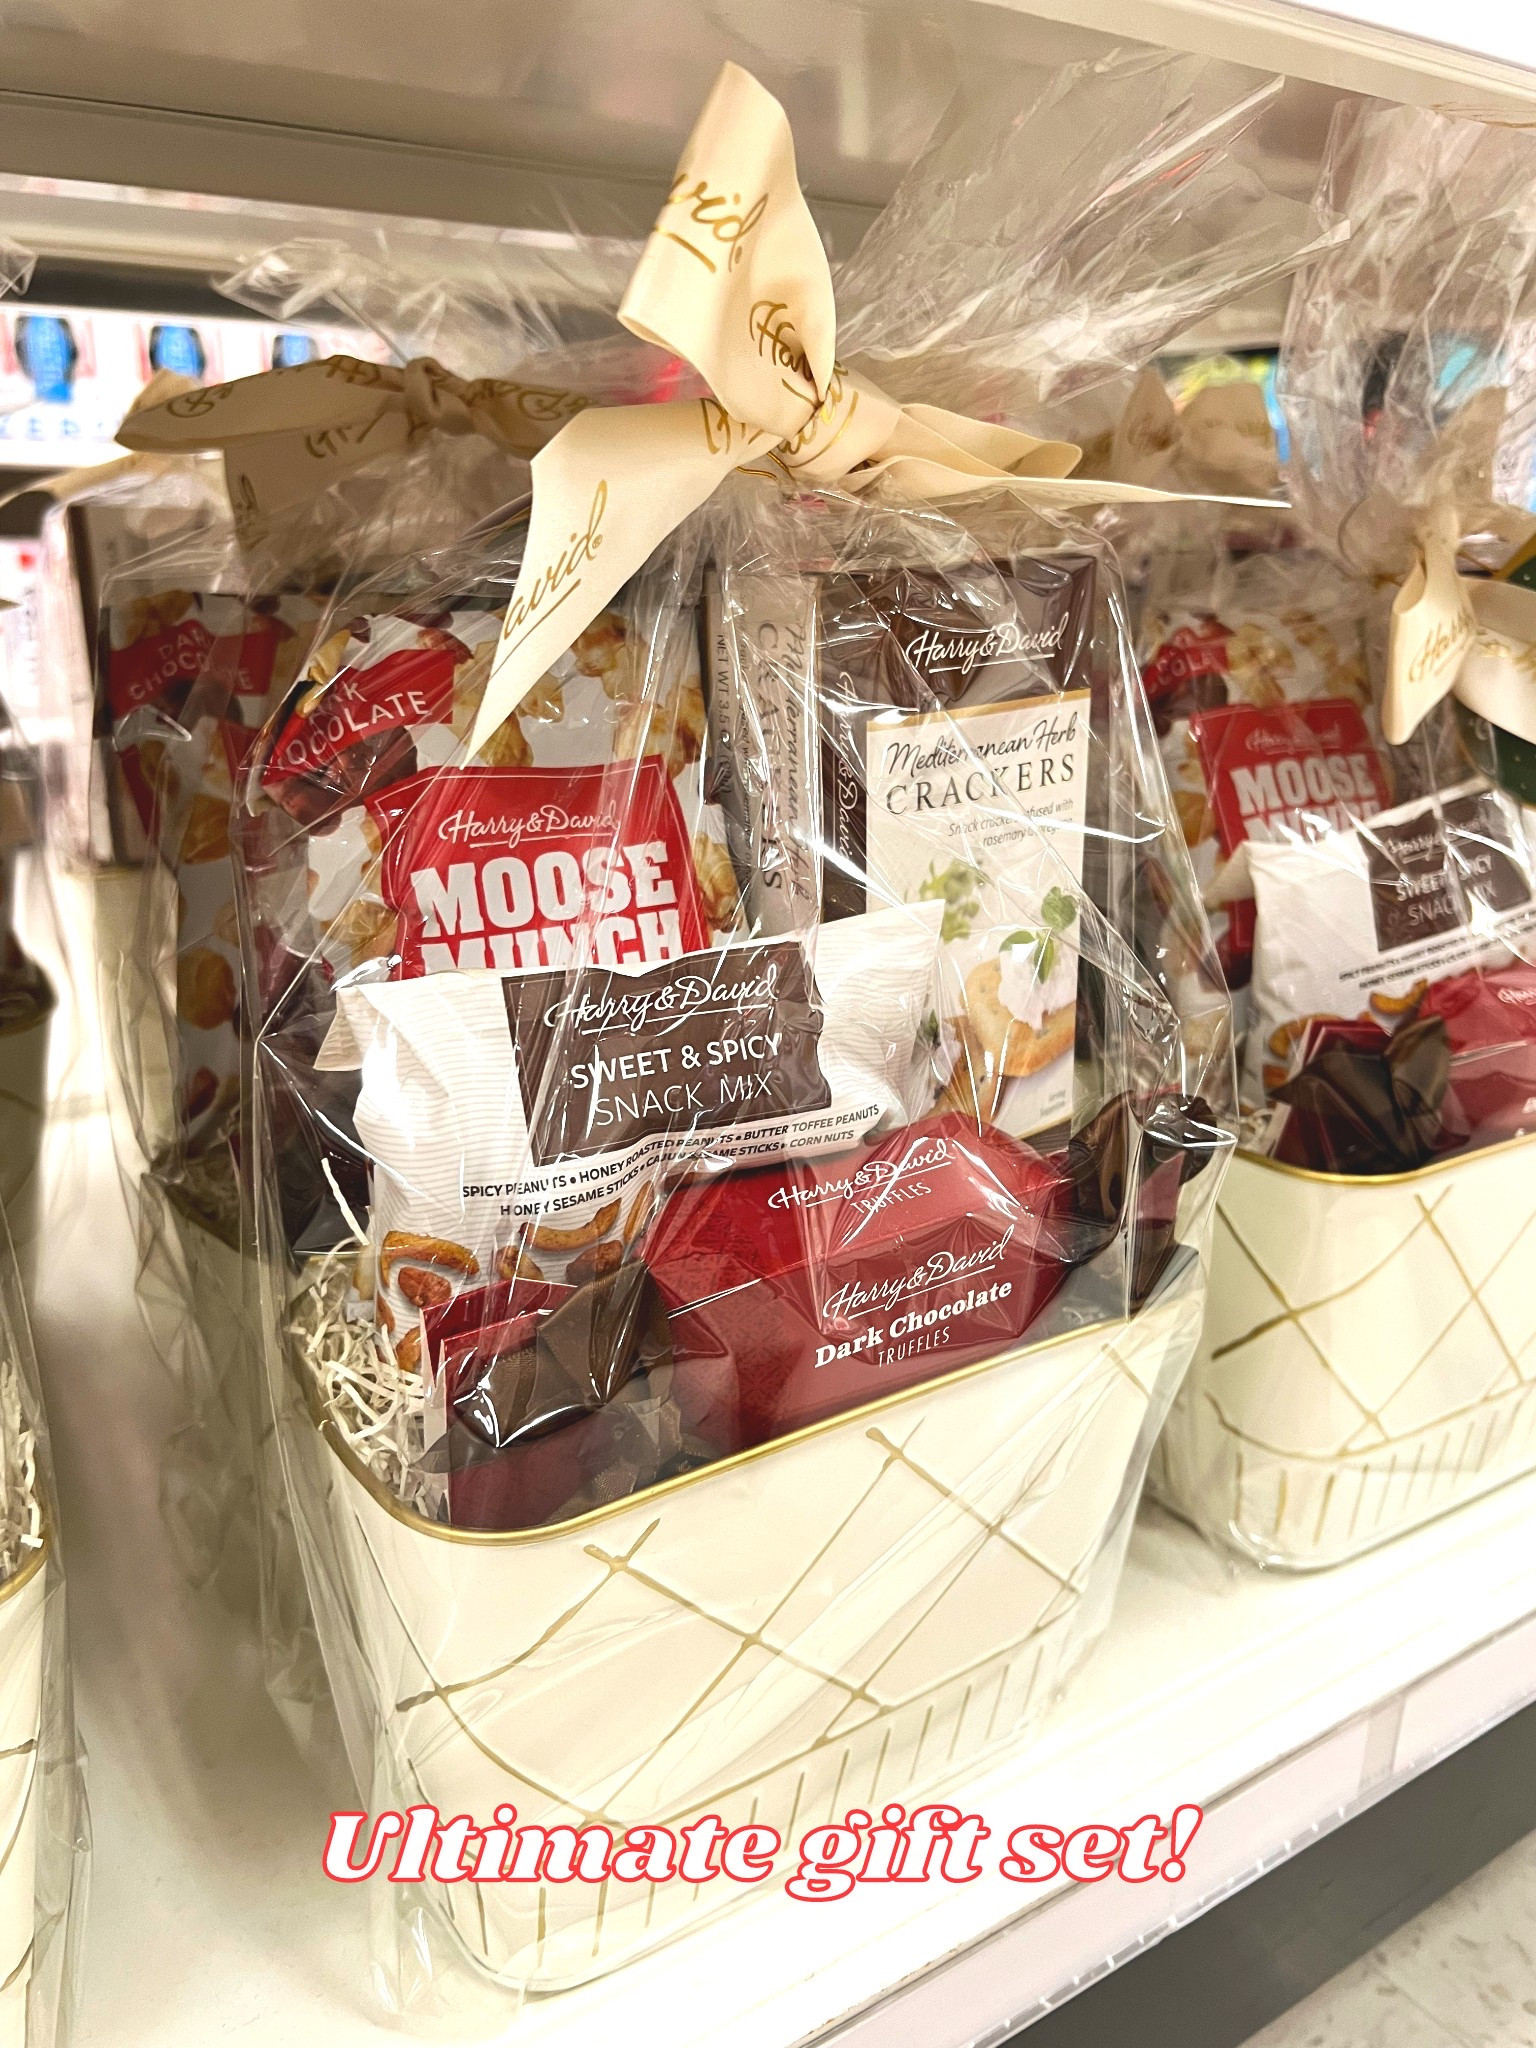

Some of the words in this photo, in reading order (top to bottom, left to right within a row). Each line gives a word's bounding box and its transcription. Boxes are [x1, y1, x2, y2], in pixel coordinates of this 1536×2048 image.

[716, 670, 730, 694] WT
[717, 700, 731, 724] 3.5
[781, 624, 809, 824] Medterranean
[1031, 711, 1079, 753] Herb
[886, 752, 1076, 816] CRACKERS
[1230, 752, 1377, 818] MOOSE
[410, 840, 677, 939] MOOSE
[570, 1047, 672, 1090] SWEET
[681, 1044, 702, 1070] &
[708, 1032, 782, 1066] SPICY
[595, 1080, 704, 1127] SNACK
[719, 1070, 774, 1102] MIX
[462, 1184, 503, 1198] SPICY
[578, 1160, 626, 1185] HONEY
[625, 1139, 675, 1167] ROASTED
[743, 1124, 789, 1141] BUTTER
[792, 1117, 834, 1132] TOFFEE
[835, 1103, 880, 1126] PEANUTS
[552, 1186, 605, 1212] SESAME
[605, 1167, 640, 1194] STICKS
[738, 1142, 780, 1157] STICKS
[789, 1134, 825, 1149] CORN
[825, 1129, 855, 1144] NUTS
[813, 1321, 884, 1369] Dark
[888, 1279, 1013, 1339] Chocolate
[877, 1325, 951, 1369] TRUFFLES
